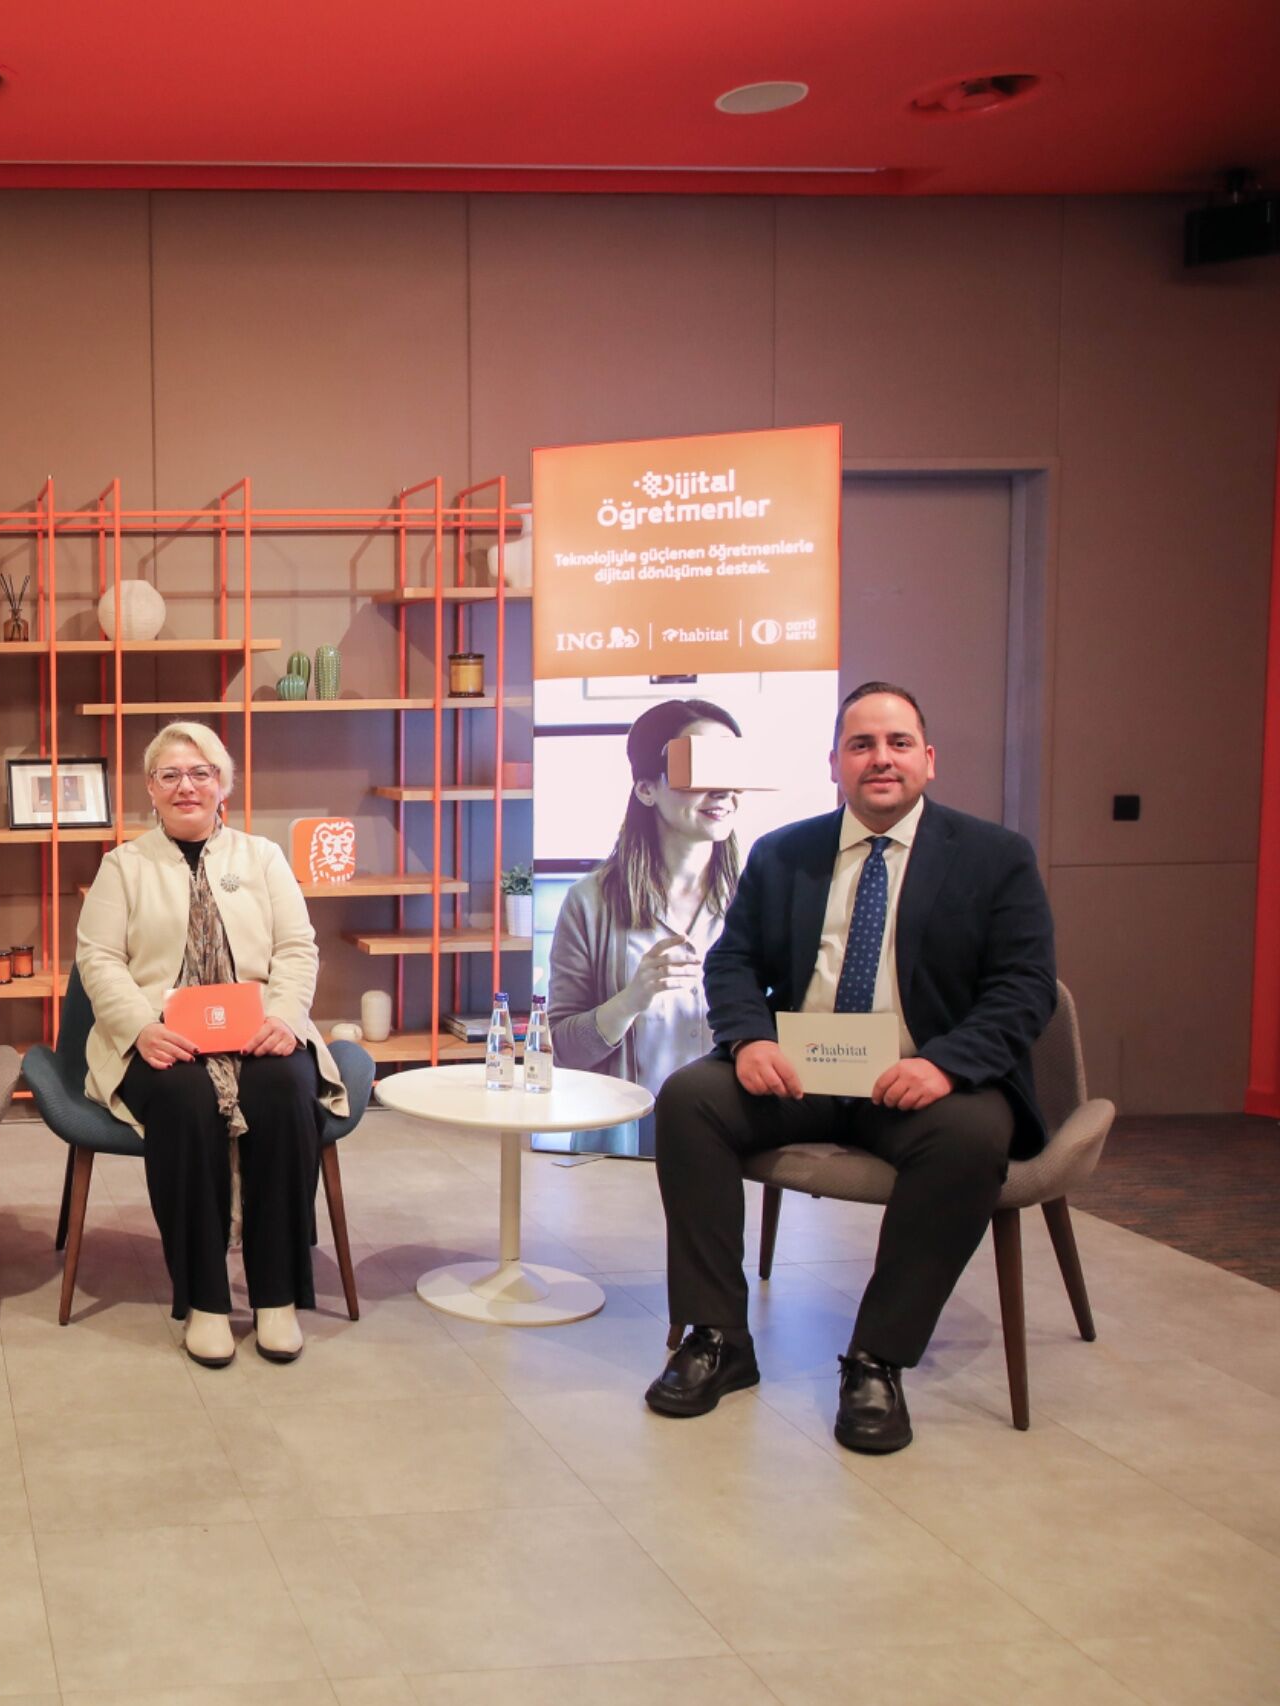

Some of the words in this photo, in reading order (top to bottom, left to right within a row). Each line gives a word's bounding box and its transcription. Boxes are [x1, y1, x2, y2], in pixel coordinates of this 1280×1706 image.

[597, 496, 770, 529] Öğretmenler
[554, 551, 637, 568] Teknolojiyle
[640, 546, 705, 565] güçlenen
[708, 540, 814, 560] öğretmenlerle
[594, 565, 635, 584] dijital
[638, 562, 713, 581] dönüşüme
[716, 560, 770, 576] destek.
[556, 632, 604, 651] ING
[679, 628, 730, 643] habitat
[820, 1043, 867, 1056] habitat
